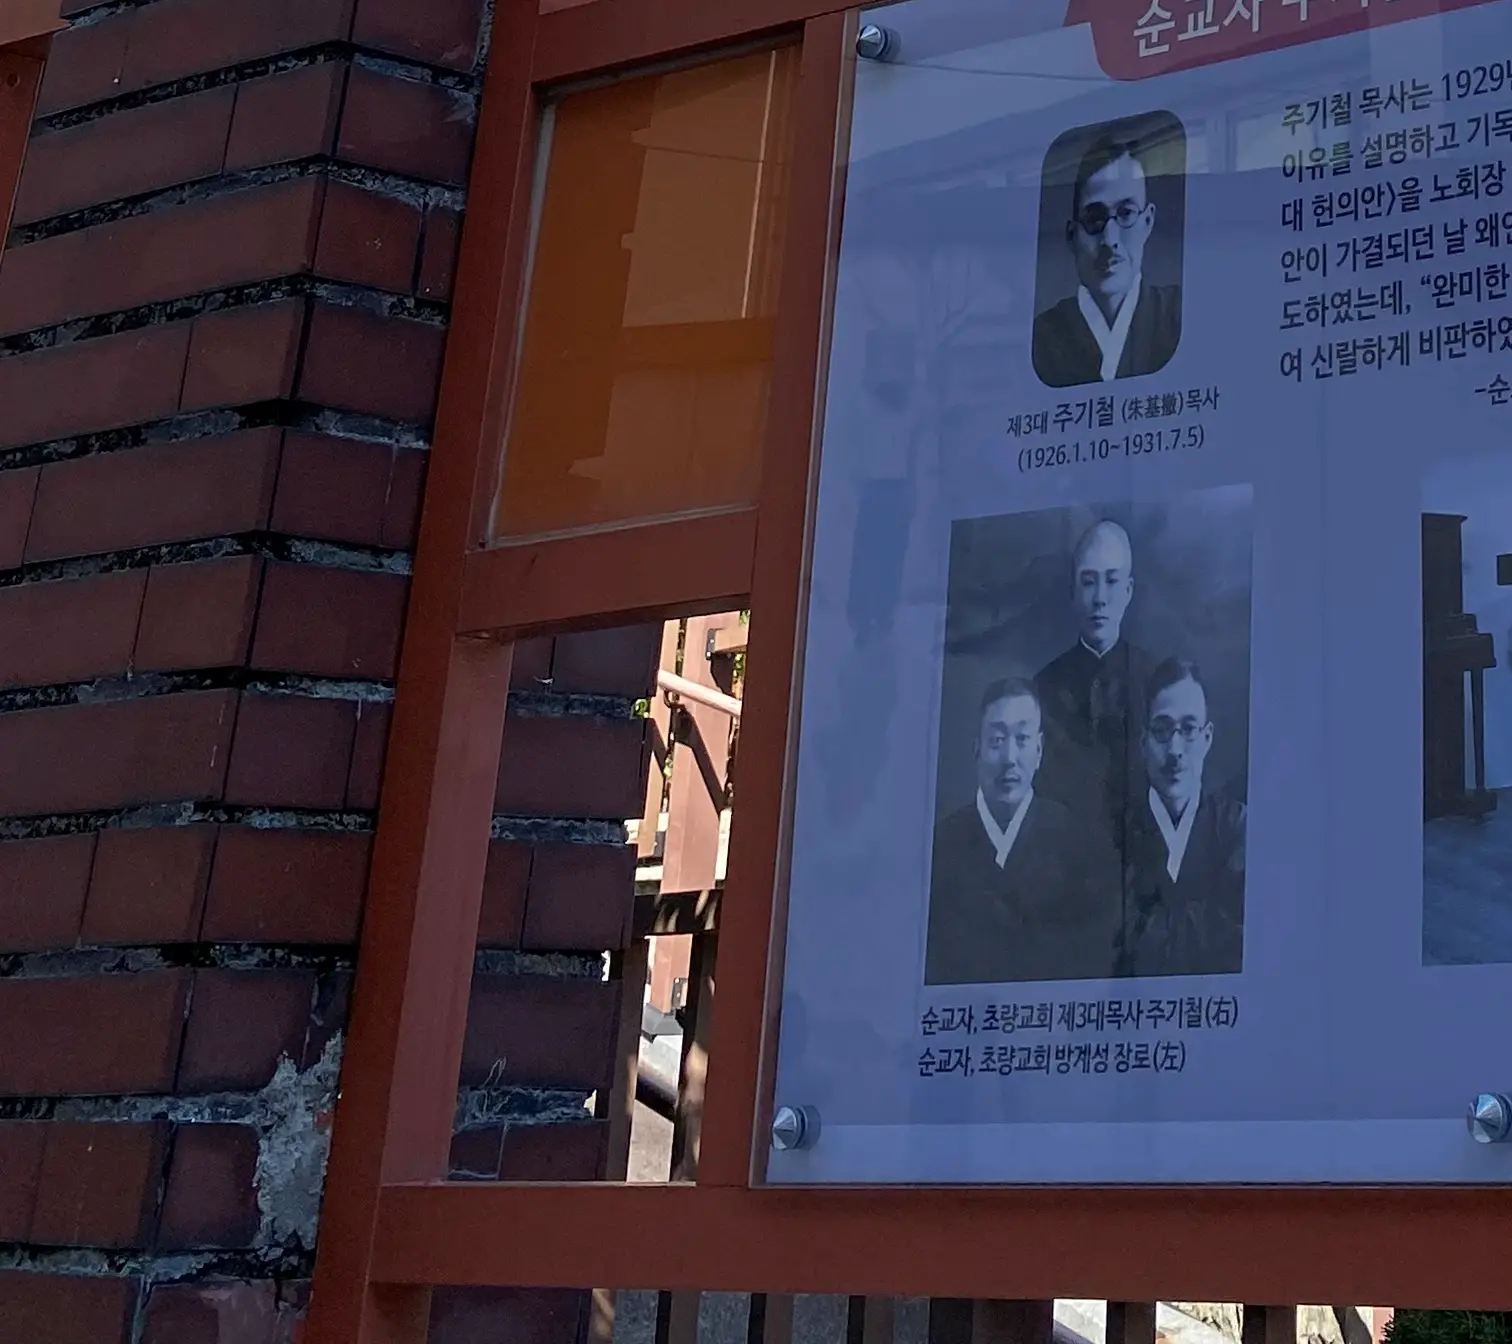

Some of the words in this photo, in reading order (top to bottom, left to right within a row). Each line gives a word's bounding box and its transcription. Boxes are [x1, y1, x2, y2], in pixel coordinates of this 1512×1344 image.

[1281, 92, 1353, 137] 주기철
[1359, 78, 1433, 118] 목사는
[1281, 140, 1354, 184] 이유를
[1360, 123, 1460, 171] 설명하고
[1281, 196, 1303, 232] 대
[1429, 159, 1507, 204] 노회장
[1281, 244, 1328, 284] 안이
[1335, 225, 1435, 273] 가결되던
[1442, 215, 1468, 254] 날
[1279, 280, 1412, 332] 도하였는데,
[1280, 348, 1304, 383] 여
[1310, 330, 1411, 380] 신랄하게
[1006, 410, 1048, 438] 제3대
[1053, 395, 1114, 433] 주기철
[1017, 424, 1205, 472] (1926.1.10~1931.7.5)
[921, 1005, 977, 1036] 순교자,
[981, 1002, 1053, 1033] 초량교회
[917, 1046, 975, 1077] 순교자,
[979, 1044, 1050, 1075] 초량교회
[1055, 1042, 1110, 1074] 방계성
